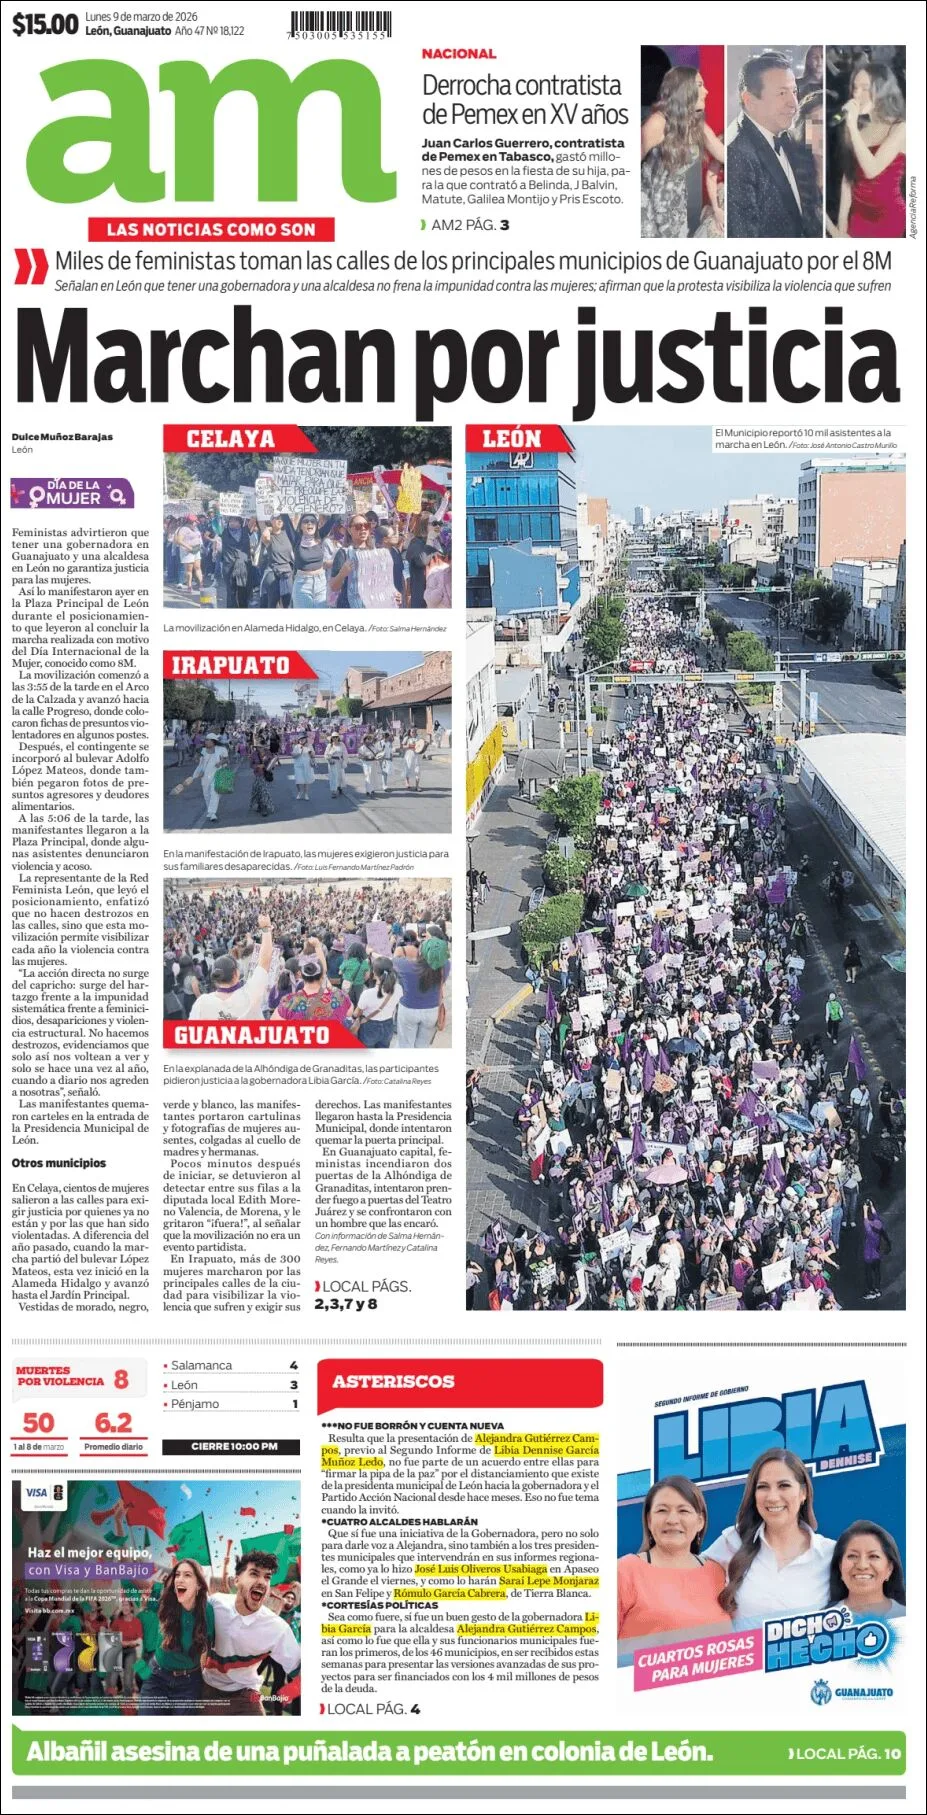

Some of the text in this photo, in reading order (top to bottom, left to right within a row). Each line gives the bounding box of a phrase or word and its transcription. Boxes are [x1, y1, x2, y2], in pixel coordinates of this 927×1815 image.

[86, 12, 198, 22] Lunes 9 de marzo de 2026
[12, 12, 79, 37] $15.00
[86, 25, 112, 37] León,
[113, 26, 172, 37] Guanajuato
[175, 26, 193, 35] Año
[194, 26, 204, 35] 47
[220, 26, 244, 36] 18,122
[422, 48, 497, 59] NACIONAL
[424, 73, 622, 96] Derrocha contratista
[423, 102, 629, 124] de Pemex en XV años
[26, 58, 397, 204] am
[422, 138, 625, 149] Juan Carlos Guerrero, contratista
[108, 223, 315, 236] LAS NOTICIAS COMO SON
[432, 217, 510, 230] AM2 PÁG. 3
[56, 250, 891, 274] Miles de feministas toman las calles de los principales municipios de Guanajuato por el 8M
[17, 304, 901, 422] Marchan por justicia
[40, 432, 74, 440] Muñoz
[74, 433, 113, 442] Barajas
[187, 430, 275, 448] CELAYA
[483, 425, 541, 447] LEÓN
[12, 446, 33, 454] León
[48, 479, 100, 489] DÍA DE LA
[46, 491, 100, 504] MUJER
[12, 528, 149, 539] Feministas advirtieron que
[164, 624, 174, 632] La
[175, 624, 230, 632] movilización
[244, 624, 284, 632] Alameda
[286, 624, 322, 634] Hidalgo,
[334, 624, 367, 634] Celaya.
[172, 656, 289, 674] IRAPUATO
[175, 1026, 329, 1044] GUANAJUATO
[12, 1158, 106, 1170] Otros municipios
[323, 1278, 412, 1292] LOCAL PÁGS.
[314, 1298, 378, 1312] 2,3,7 y 8
[16, 1366, 70, 1375] MUERTES
[171, 1360, 232, 1370] Salamanca
[290, 1361, 298, 1370] 4
[18, 1378, 104, 1386] POR VIOLENCIA
[114, 1369, 129, 1390] 8
[172, 1380, 198, 1390] León
[290, 1380, 298, 1390] 3
[332, 1375, 454, 1388] ASTERISCOS
[654, 1385, 749, 1408] SEGUNDO INFORME DE GOBIERNO
[172, 1399, 220, 1411] Pénjamo
[293, 1400, 298, 1408] 1
[23, 1412, 55, 1433] 50
[95, 1412, 132, 1433] 6.2
[354, 1422, 374, 1430] FUE
[375, 1420, 418, 1430] BORRÓN
[419, 1422, 426, 1430] Y
[427, 1422, 468, 1430] CUENTA
[470, 1422, 504, 1430] NUEVA
[654, 1379, 881, 1483] LIBIA
[192, 1442, 229, 1450] CIERRE
[262, 1442, 278, 1450] PM
[819, 1452, 873, 1471] DENNISE
[26, 1488, 48, 1497] VISA
[28, 1546, 154, 1561] Haz el mejor equipo,
[28, 1564, 151, 1579] con Visa y BanBajío
[385, 1599, 439, 1609] POLÍTICAS
[637, 1636, 755, 1668] CUARTOS ROSAS
[766, 1623, 886, 1671] HECHO
[651, 1653, 755, 1683] PARA MUJERES
[835, 1688, 894, 1697] GUANAJUATO
[328, 1701, 421, 1715] LOCAL PÁG. 4
[26, 1739, 713, 1765] Albañil asesina de una puñalada a peatón en colonia de León.
[797, 1745, 902, 1760] LOCAL PÁG. 10
